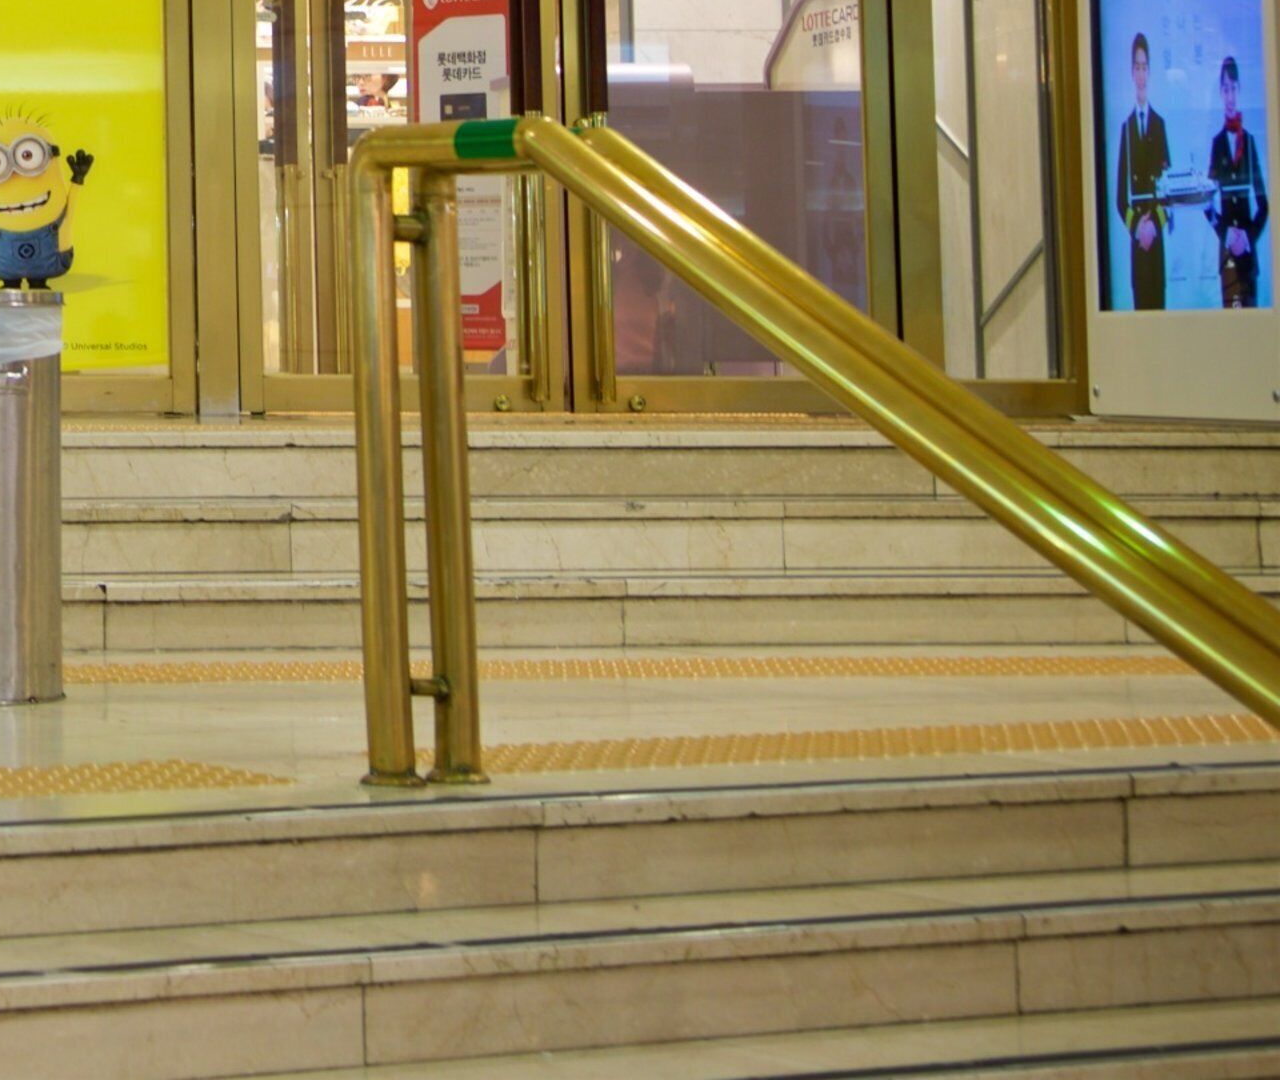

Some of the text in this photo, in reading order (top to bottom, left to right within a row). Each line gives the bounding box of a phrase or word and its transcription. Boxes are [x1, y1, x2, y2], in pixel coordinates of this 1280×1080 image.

[437, 50, 487, 68] 롯데백화점
[442, 66, 483, 82] 롯데카드
[70, 341, 112, 351] Universal
[114, 341, 148, 351] Studios
